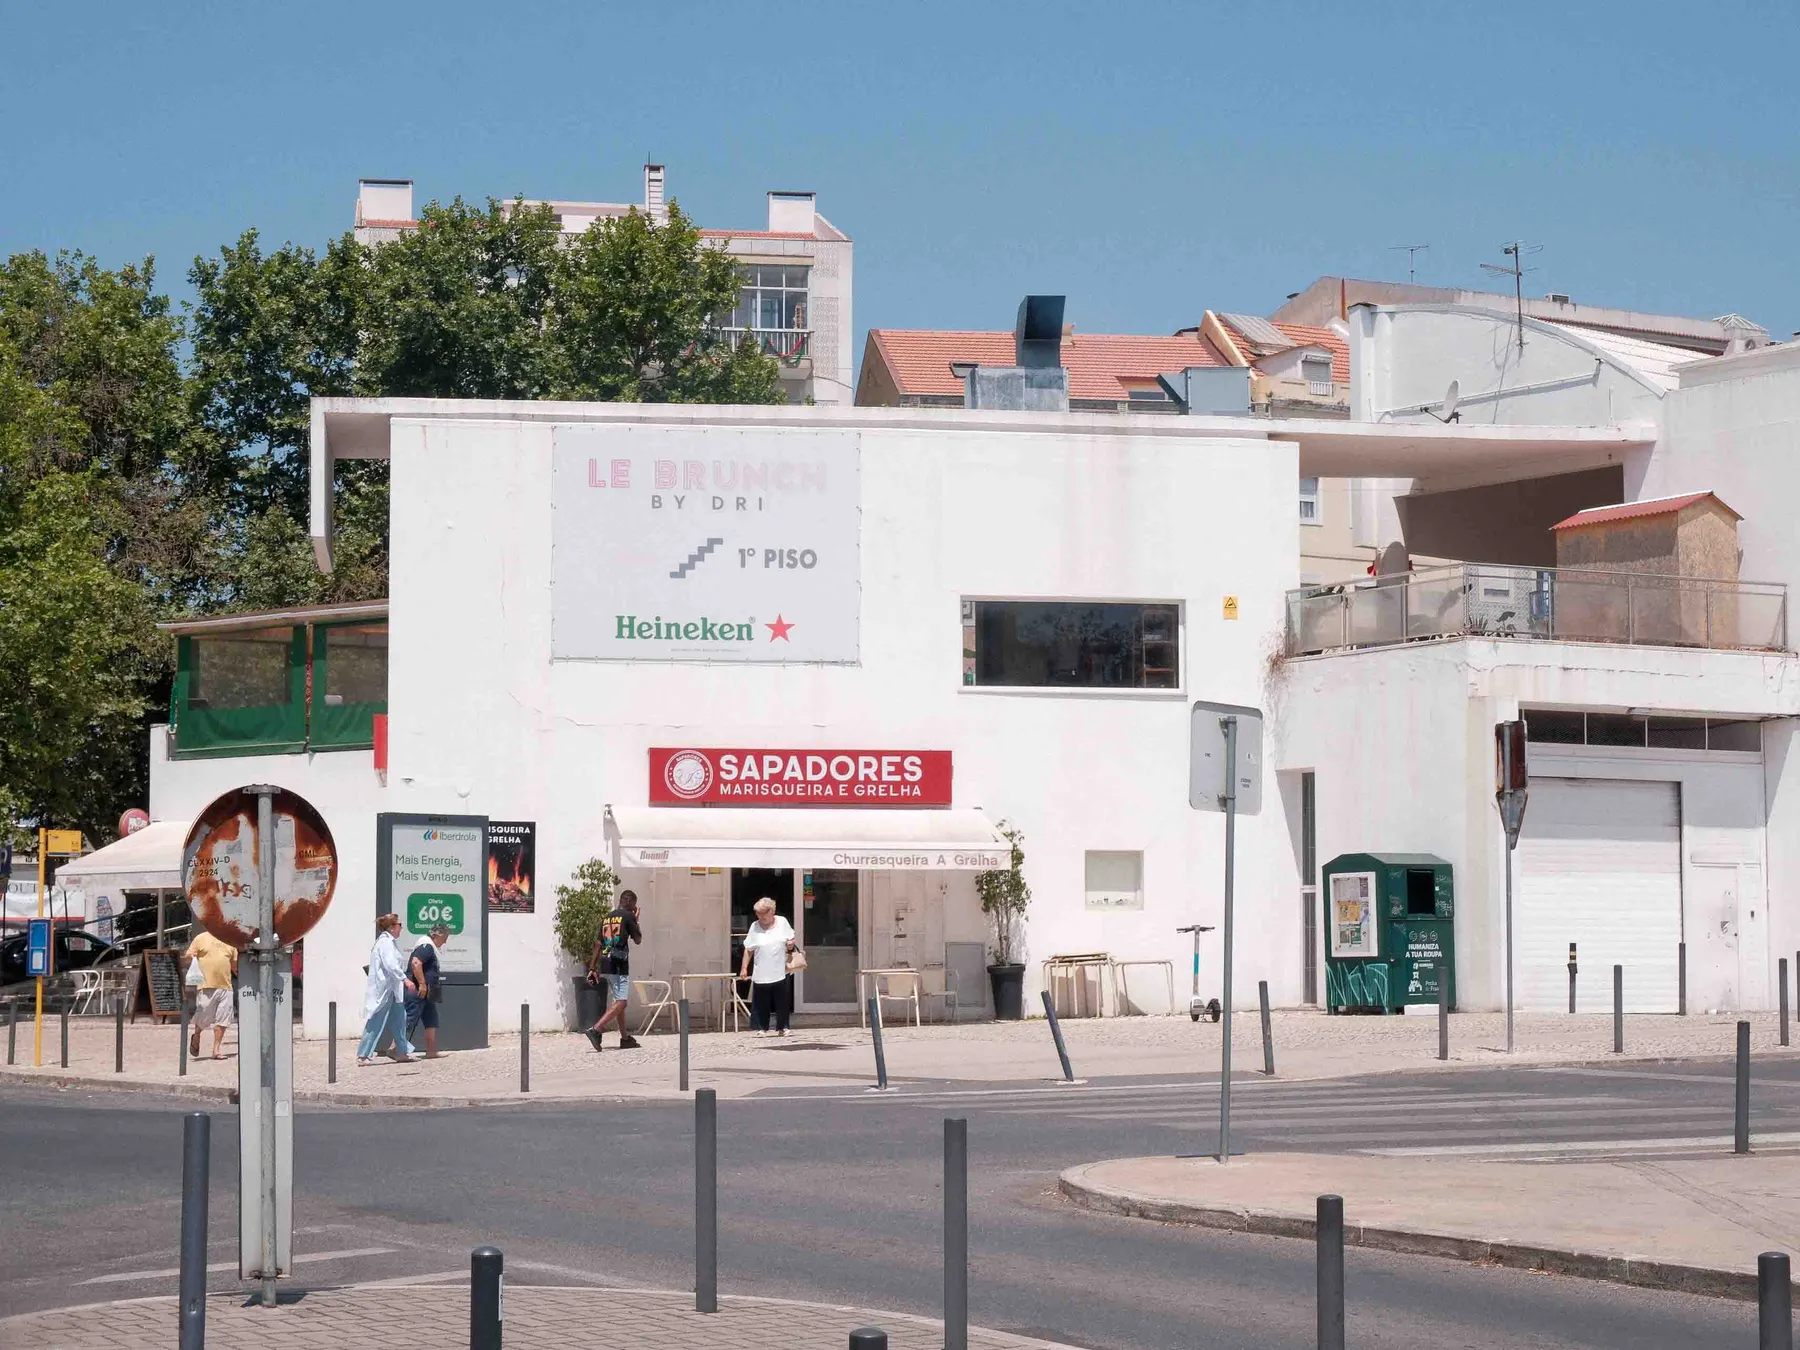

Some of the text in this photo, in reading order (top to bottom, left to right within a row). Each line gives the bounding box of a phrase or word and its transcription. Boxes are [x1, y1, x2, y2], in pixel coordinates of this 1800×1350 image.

[588, 458, 828, 493] LE BRUNCH
[651, 495, 762, 511] BY DRI
[764, 548, 818, 569] PISO
[615, 615, 754, 641] Heineken
[719, 755, 922, 782] SAPADORES
[719, 783, 833, 796] MARISQUEIRA
[839, 784, 848, 796] E
[854, 784, 922, 797] GRELHA
[439, 832, 477, 842] Iberdrola
[489, 826, 531, 834] ISQUEIRA
[395, 855, 463, 867] Mais Energia,
[833, 854, 999, 868] Churrasqueira A Grelha
[395, 872, 476, 883] Mais Vantagens
